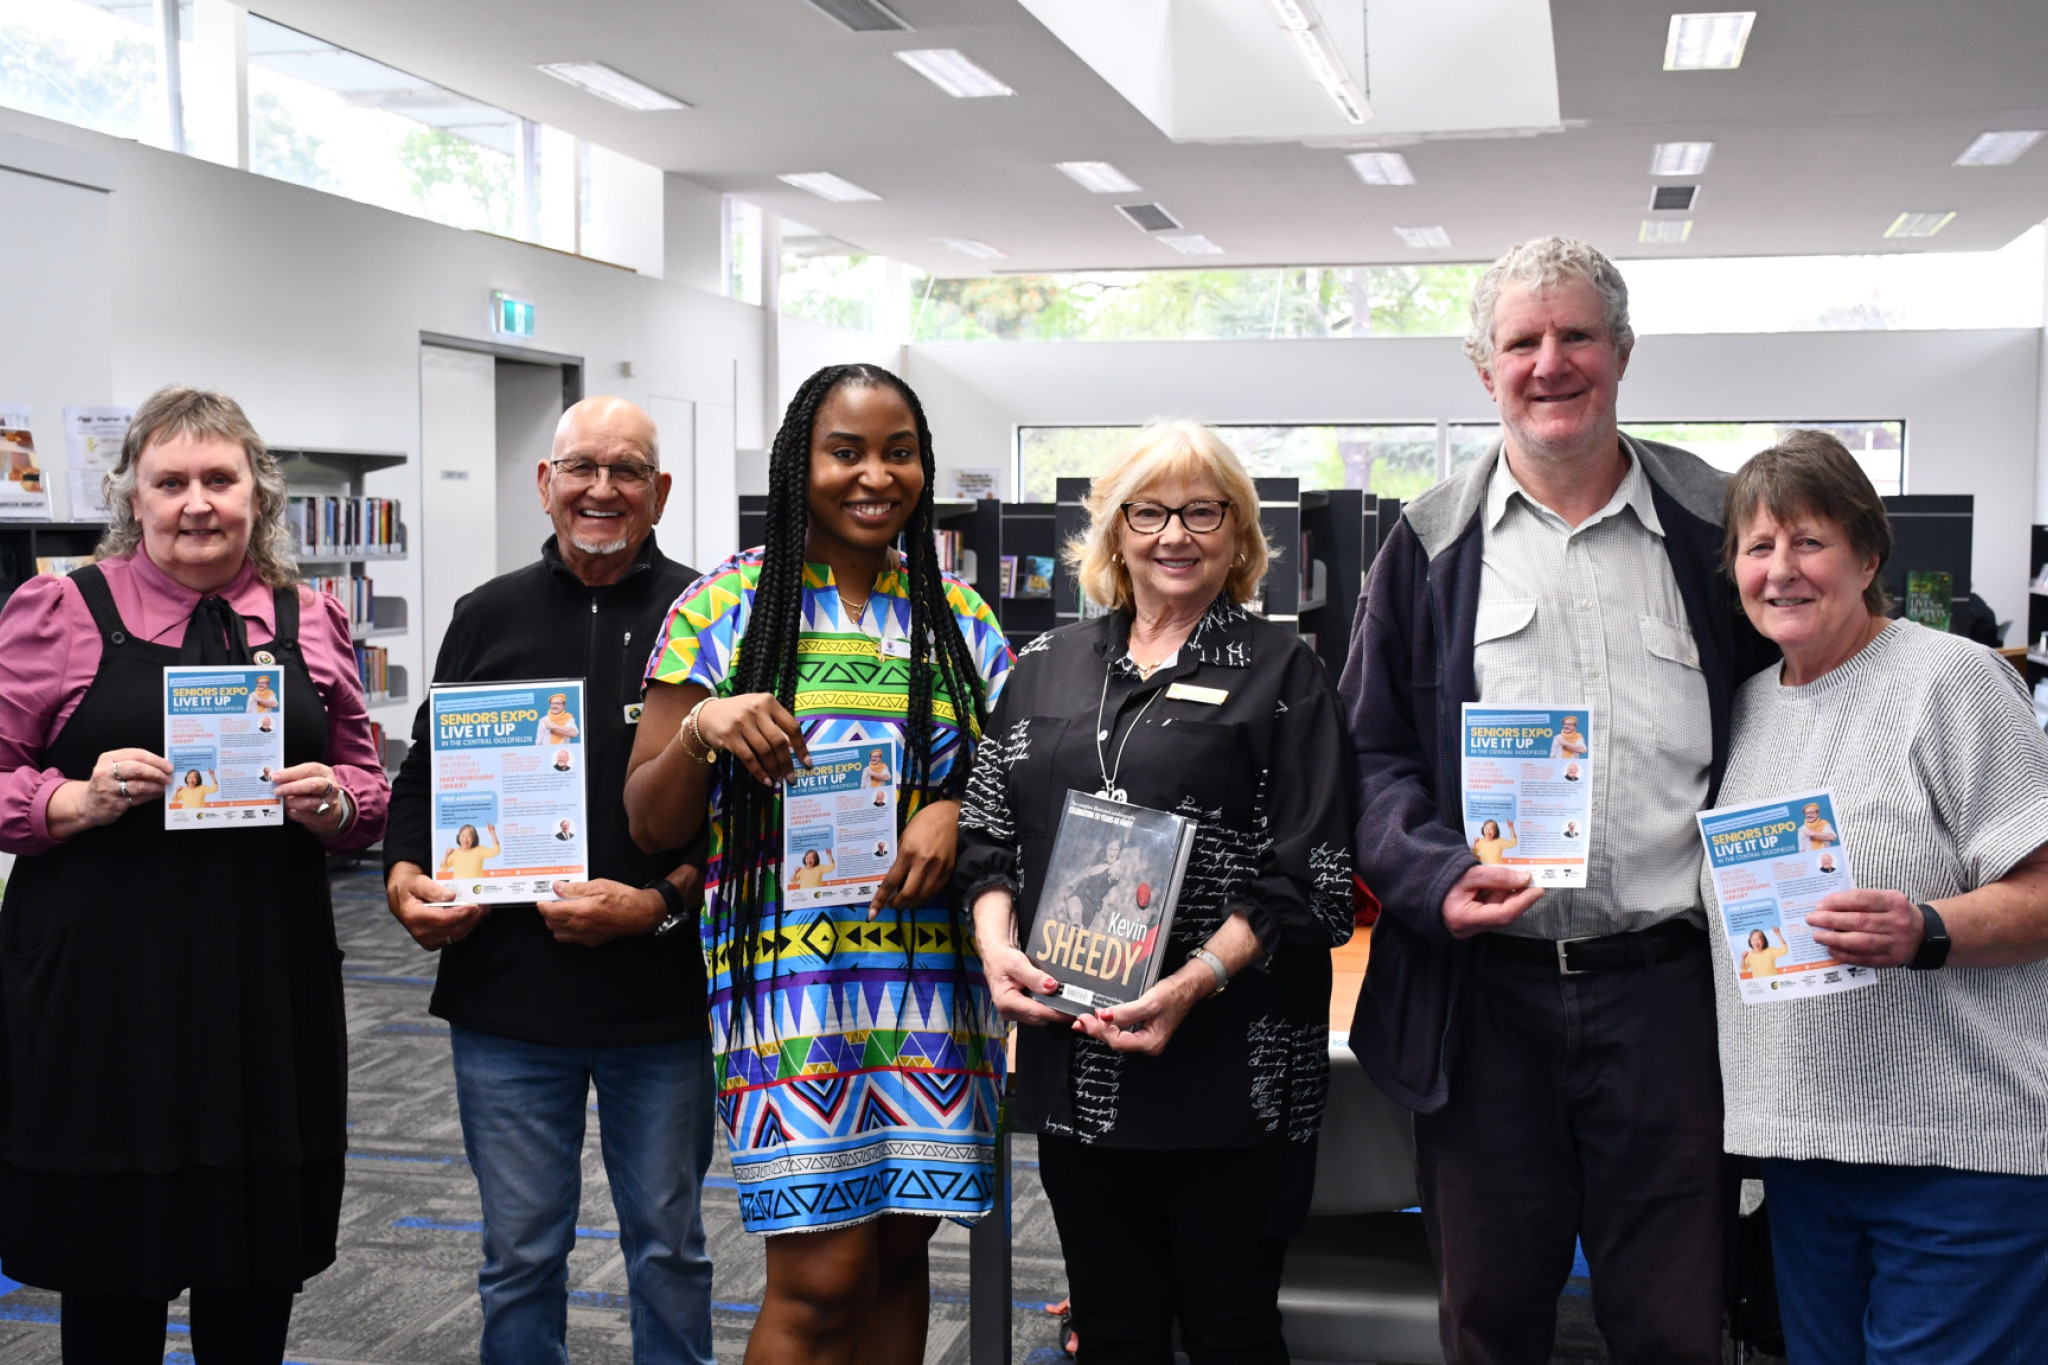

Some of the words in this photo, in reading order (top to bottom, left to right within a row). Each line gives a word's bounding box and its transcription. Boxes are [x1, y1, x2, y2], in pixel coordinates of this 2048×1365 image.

[172, 688, 218, 696] SENIORS
[220, 686, 248, 696] EXPO
[174, 696, 198, 707] LIVE
[201, 696, 212, 706] IT
[214, 696, 231, 706] UP
[440, 712, 498, 725] SENIORS
[501, 710, 538, 722] EXPO
[441, 726, 473, 740] LIVE
[476, 724, 490, 737] IT
[494, 722, 516, 736] UP
[1471, 727, 1519, 737] SENIORS
[1522, 728, 1553, 738] EXPO
[494, 736, 532, 744] GOLDFIELDS
[1471, 738, 1498, 748] LIVE
[1502, 738, 1512, 748] IT
[1516, 738, 1534, 748] UP
[835, 762, 862, 774] EXPO
[440, 774, 494, 782] MARYBOROUGH
[818, 776, 828, 785] IT
[831, 773, 846, 784] UP
[1712, 828, 1762, 846] SENIORS
[1763, 821, 1796, 836] EXPO
[1714, 842, 1743, 857] LIVE
[1745, 840, 1756, 852] IT
[1760, 836, 1778, 849] UP
[1736, 852, 1760, 860] CENTRAL
[1762, 845, 1796, 856] GOLDFIELDS
[1108, 912, 1147, 943] Kevin
[1037, 920, 1143, 986] SHEEDY
